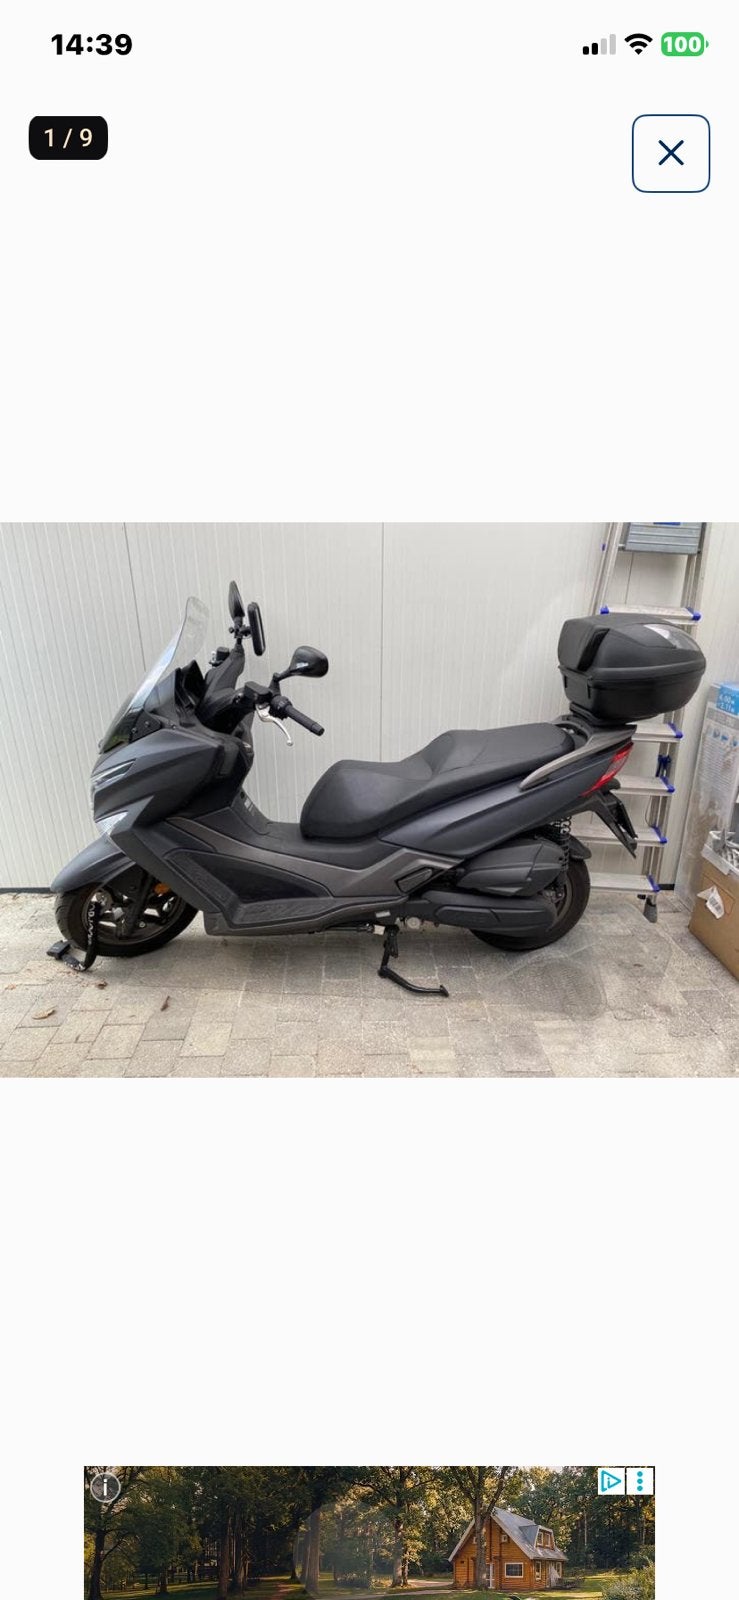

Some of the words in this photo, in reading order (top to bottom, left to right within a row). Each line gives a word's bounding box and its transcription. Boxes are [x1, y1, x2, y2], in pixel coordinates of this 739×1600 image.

[51, 34, 132, 55] 14:39
[663, 36, 702, 53] 100
[44, 128, 53, 147] 1
[79, 128, 92, 147] 9
